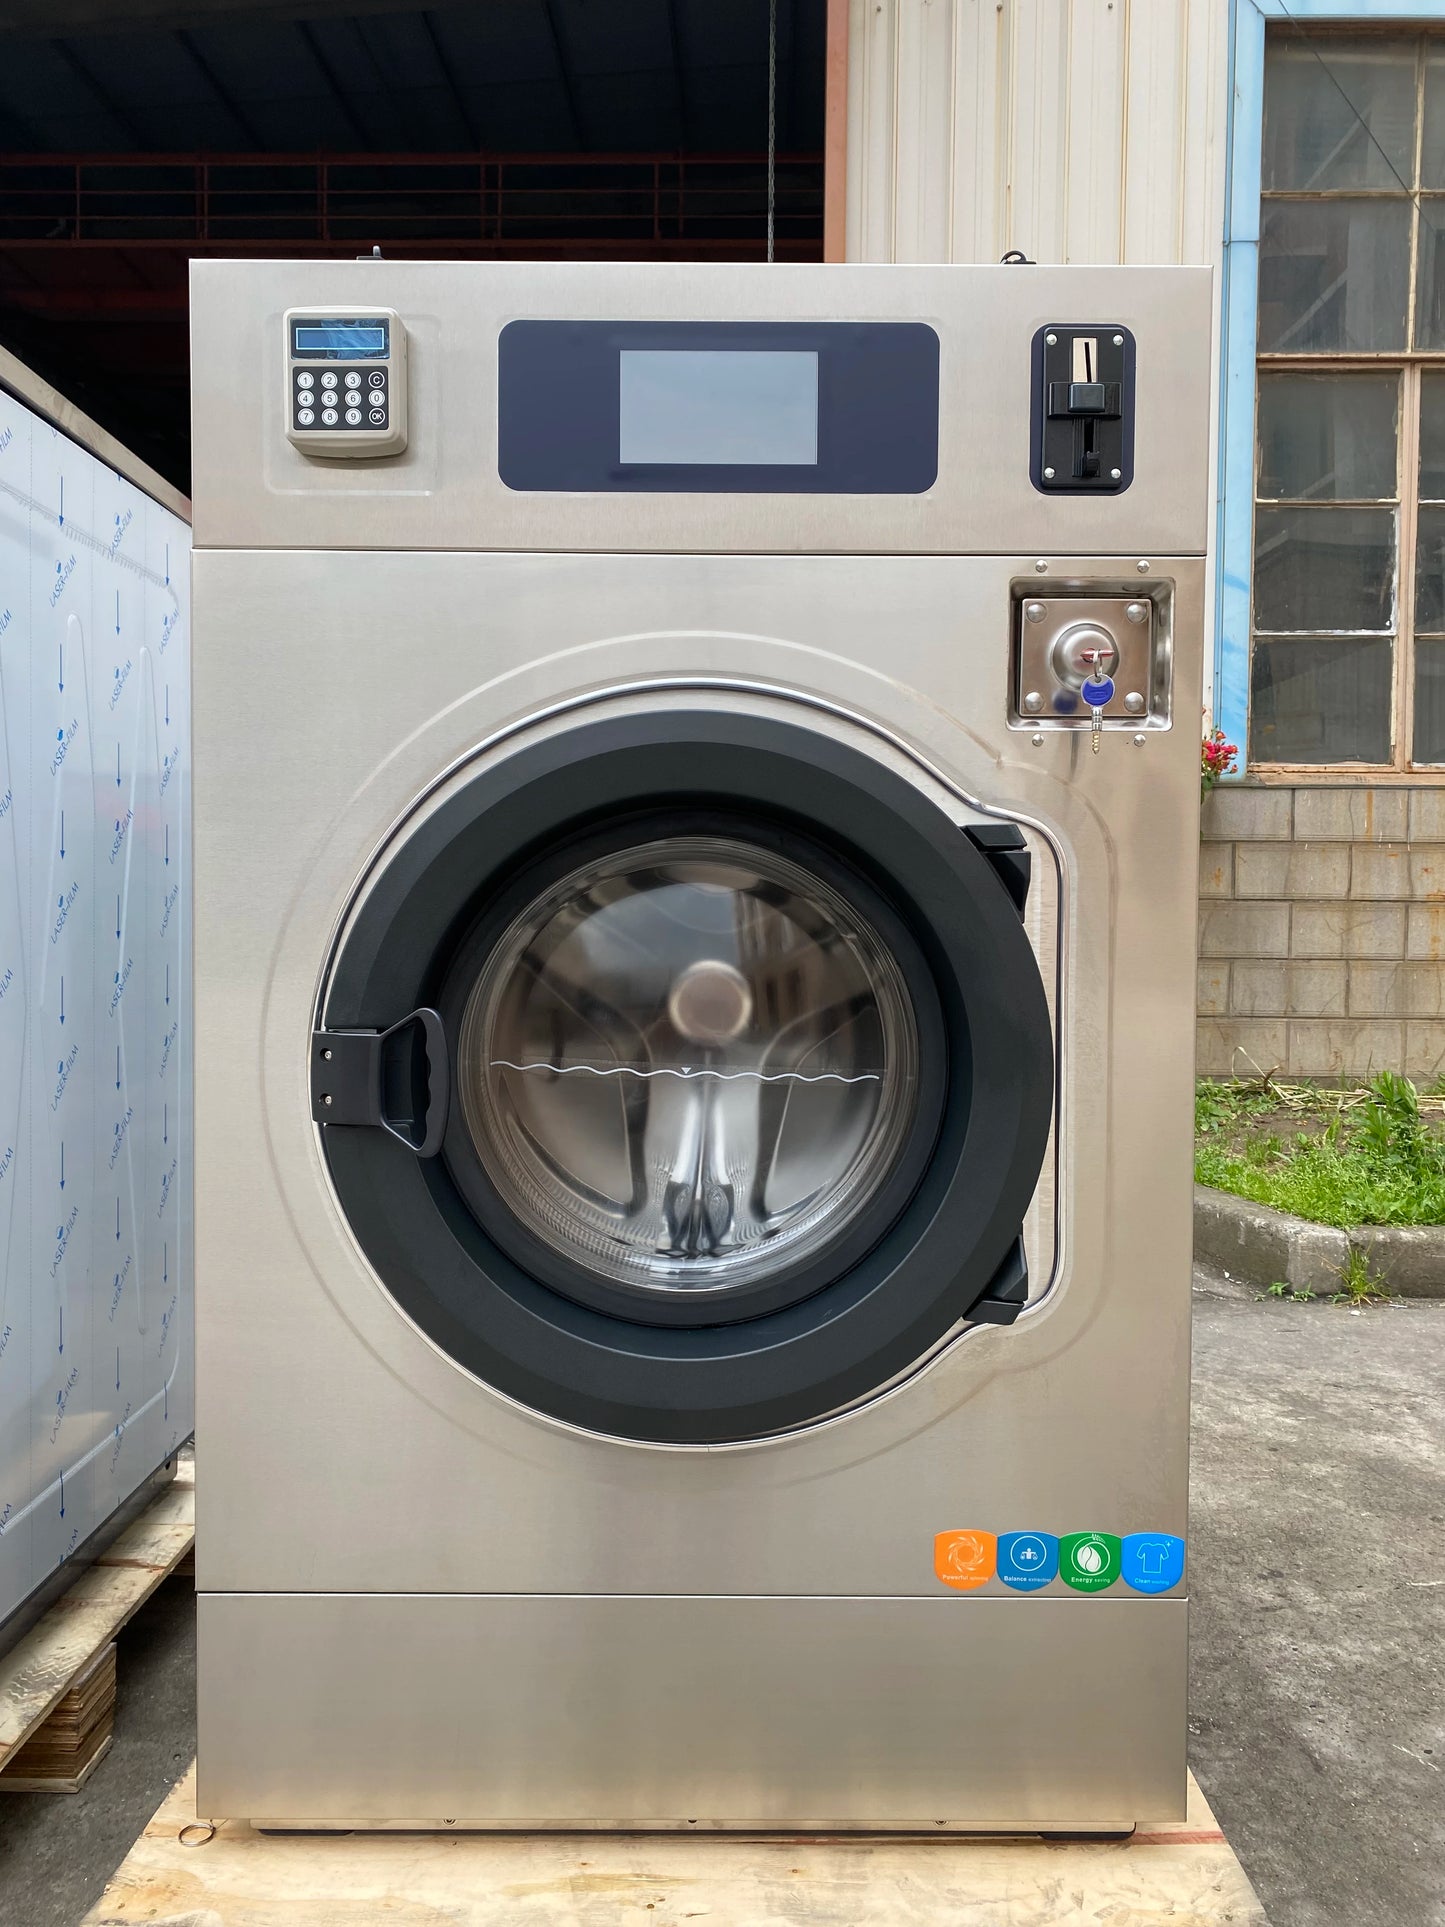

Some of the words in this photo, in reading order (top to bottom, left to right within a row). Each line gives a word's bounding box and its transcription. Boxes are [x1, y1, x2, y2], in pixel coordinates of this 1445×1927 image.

[371, 412, 383, 420] OK
[50, 555, 76, 607] LASER-FILM
[50, 720, 79, 776] LASER-FILM
[109, 809, 134, 864] LASER-FILM
[51, 882, 79, 944] LASER-FILM
[108, 958, 133, 1017] LASER-FILM
[51, 1044, 79, 1111] LASER-FILM
[108, 1107, 133, 1170] LASER-FILM
[50, 1207, 78, 1278] LASER-FILM
[108, 1256, 132, 1322] LASER-FILM
[50, 1368, 78, 1444] LASER-FILM
